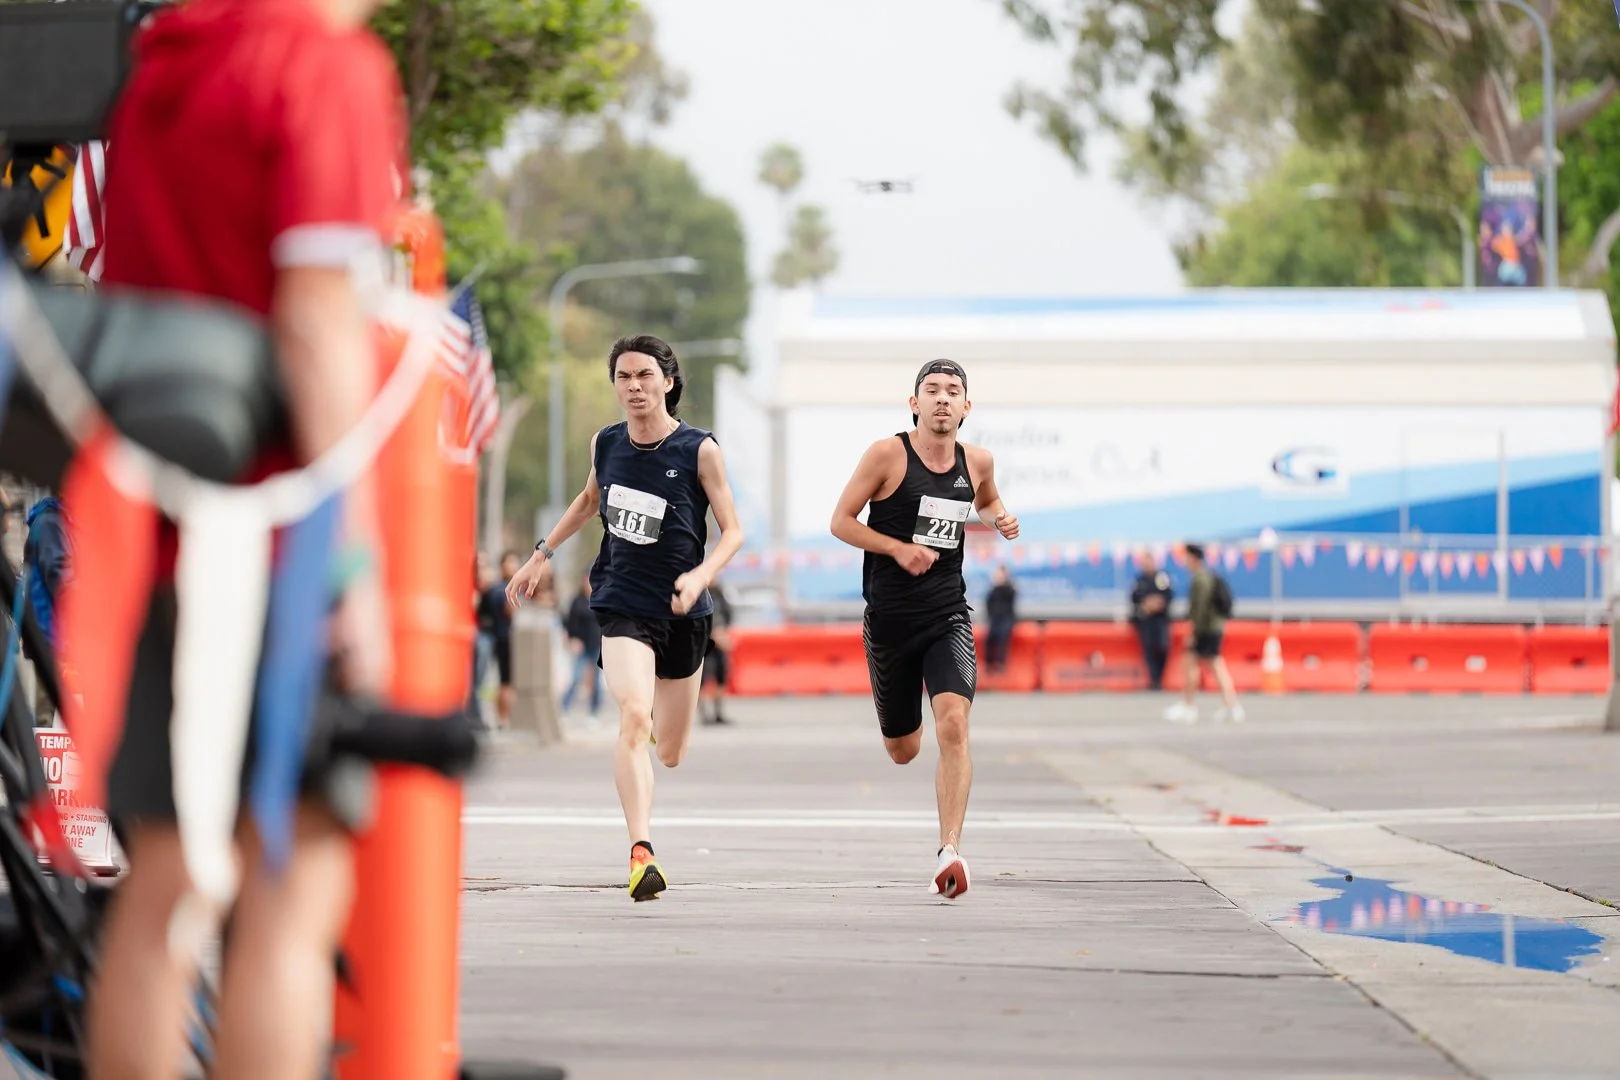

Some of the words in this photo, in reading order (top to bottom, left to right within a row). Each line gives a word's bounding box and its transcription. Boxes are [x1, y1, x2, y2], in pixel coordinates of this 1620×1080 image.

[615, 510, 647, 535] 161
[927, 519, 958, 540] 221
[76, 814, 107, 824] STANDING
[70, 825, 97, 837] AWAY
